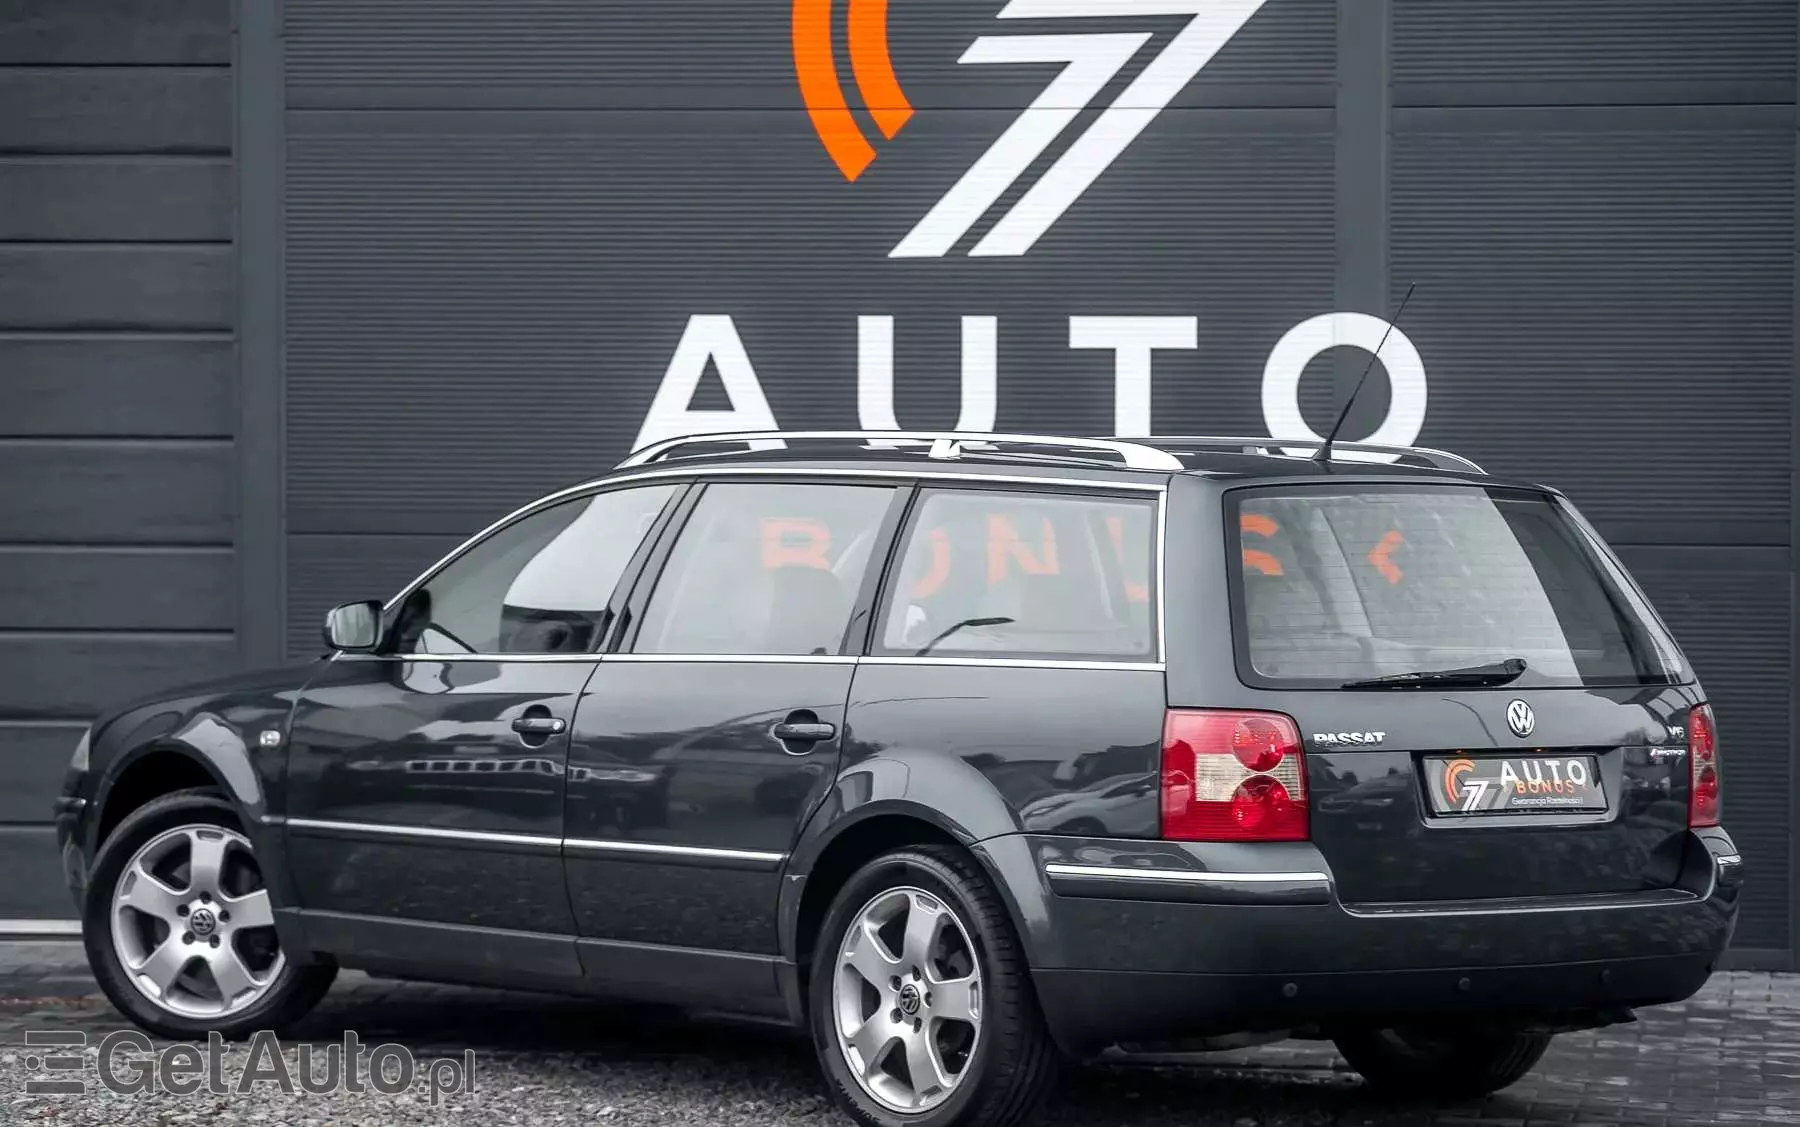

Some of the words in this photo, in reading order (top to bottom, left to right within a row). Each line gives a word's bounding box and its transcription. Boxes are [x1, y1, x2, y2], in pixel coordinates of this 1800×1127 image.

[630, 312, 1428, 463] AUTO
[1312, 731, 1387, 745] PASSAT
[1500, 759, 1587, 786] AUTO
[1516, 779, 1575, 794] BONUS
